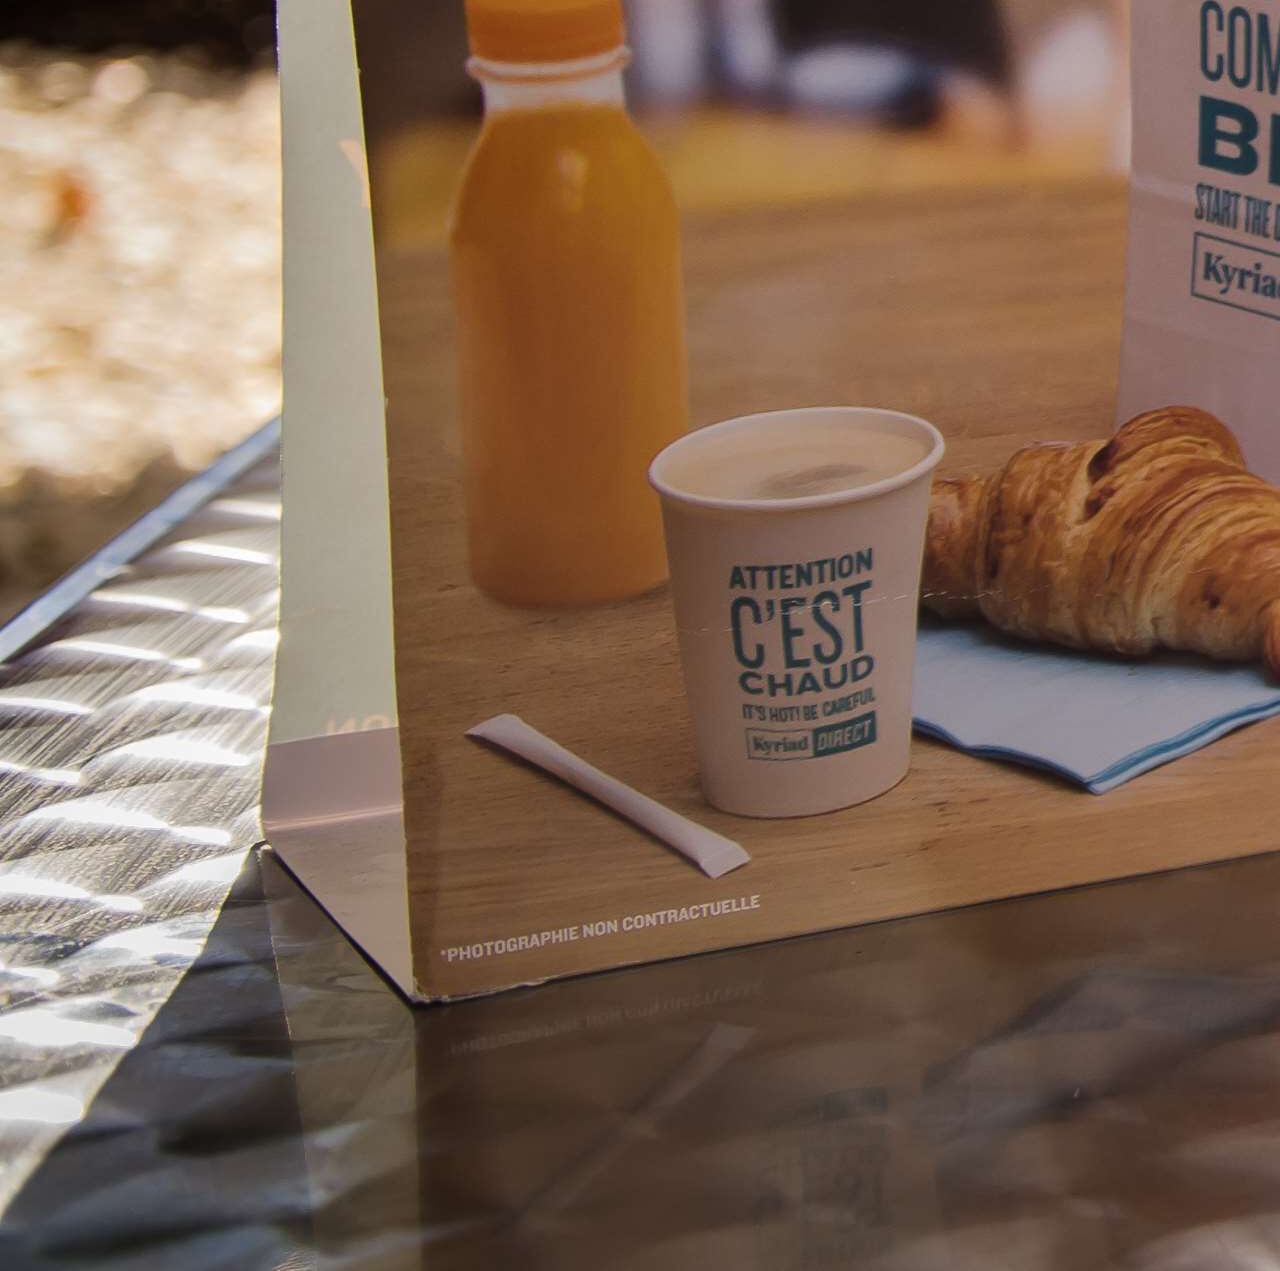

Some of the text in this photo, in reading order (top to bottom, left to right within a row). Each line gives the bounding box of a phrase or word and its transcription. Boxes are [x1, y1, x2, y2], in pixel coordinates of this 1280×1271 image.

[1195, 183, 1241, 230] START
[1244, 196, 1271, 238] THE
[729, 548, 873, 590] ATTENTION
[730, 580, 873, 669] C'EST
[738, 655, 875, 697] CHAUD
[742, 704, 766, 721] IT'S
[804, 704, 818, 720] BE
[753, 719, 872, 755] Kyriad DIRECT
[583, 920, 618, 938] NON
[622, 894, 761, 931] CONTRACTUELLE
